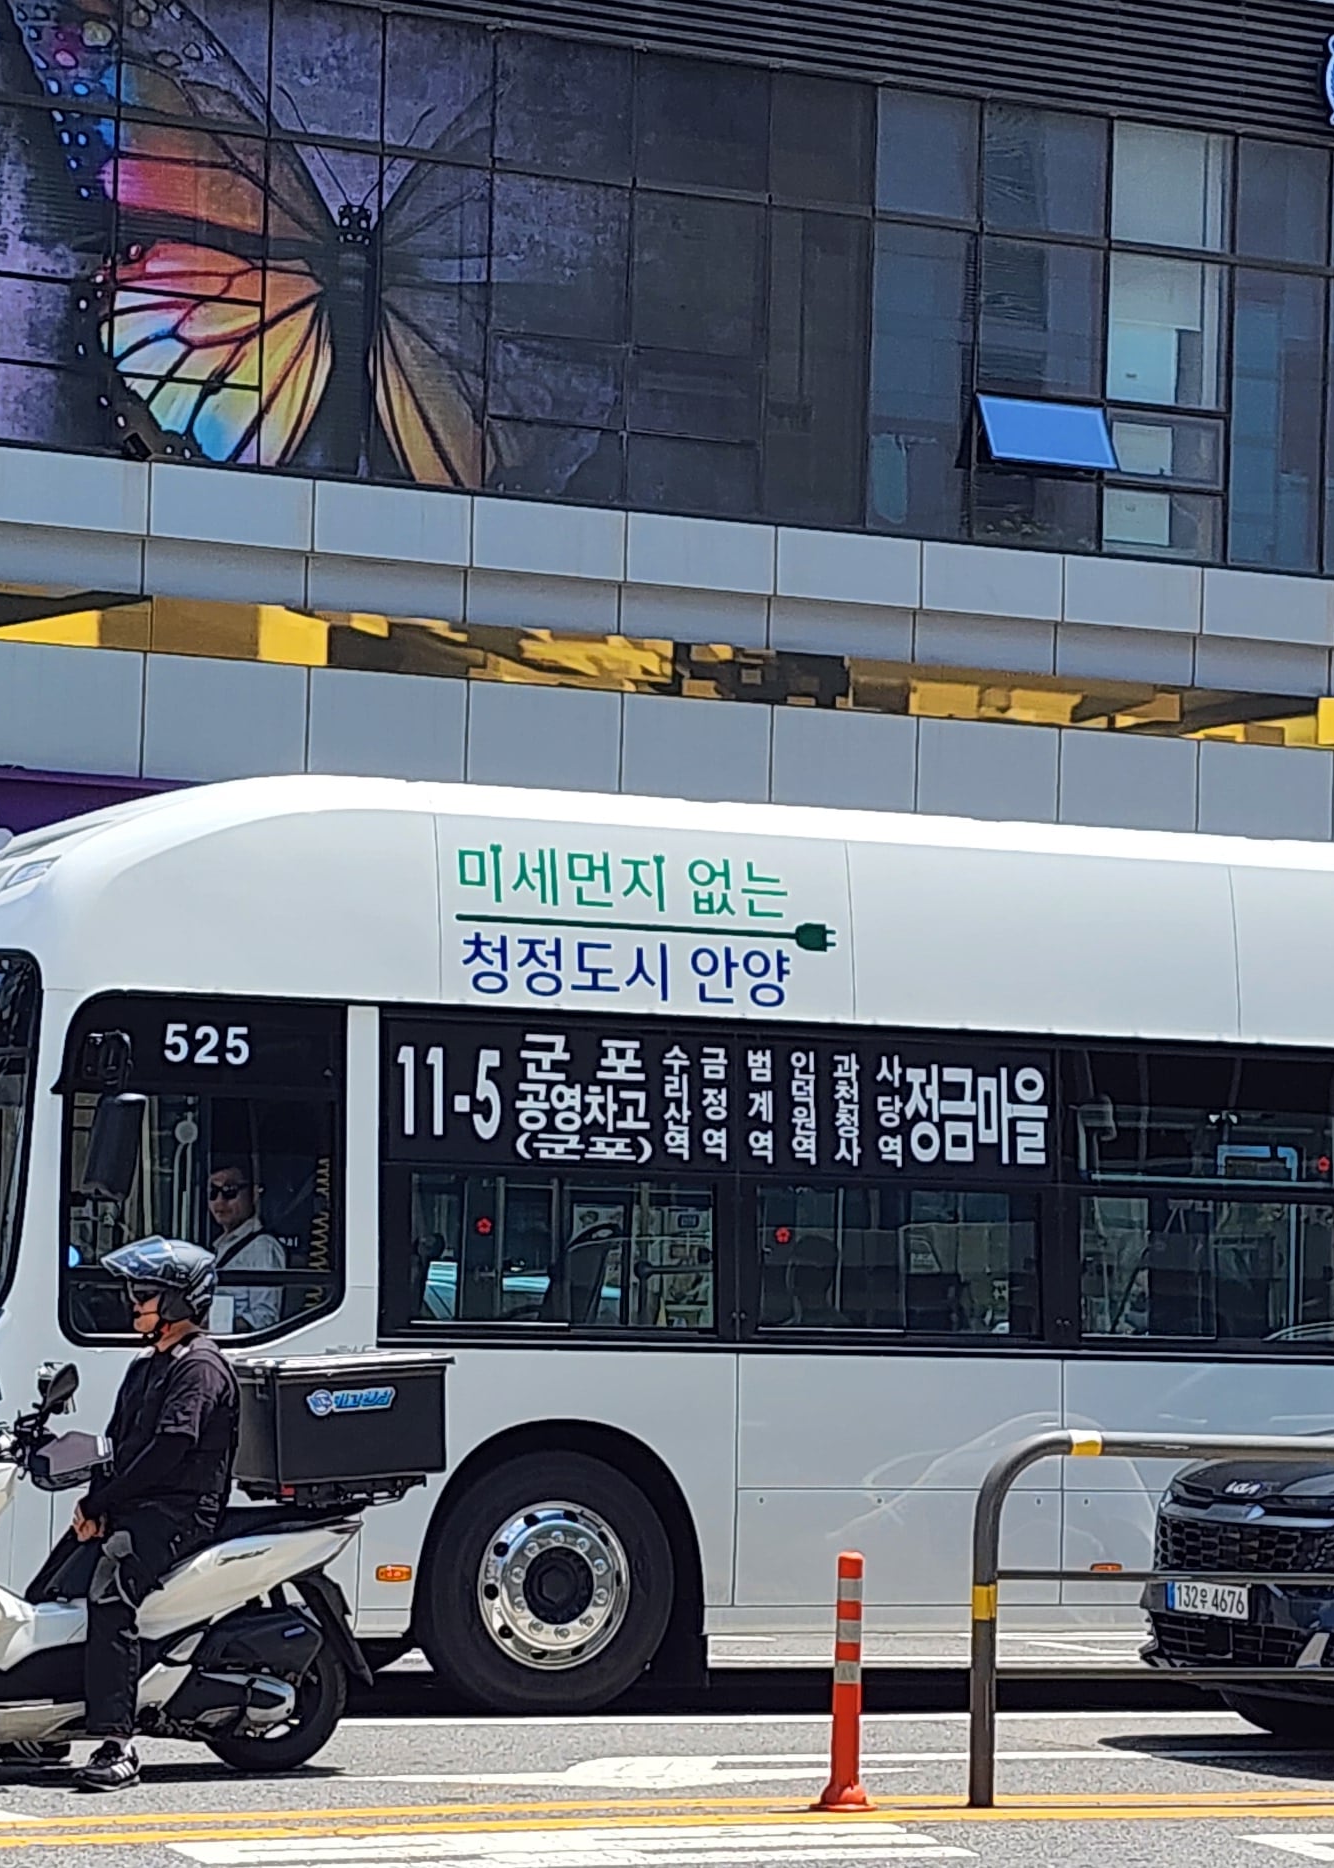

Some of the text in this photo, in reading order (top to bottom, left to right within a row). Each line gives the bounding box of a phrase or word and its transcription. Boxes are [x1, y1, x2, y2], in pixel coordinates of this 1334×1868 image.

[458, 844, 788, 918] 미세먼지 없는
[462, 932, 791, 1007] 청정도시 안양
[164, 1023, 250, 1065] 525
[397, 1046, 502, 1140] 11-5
[515, 1083, 650, 1133] 공영차고
[904, 1064, 1049, 1164] 정금마을
[515, 1132, 652, 1163] (군포)
